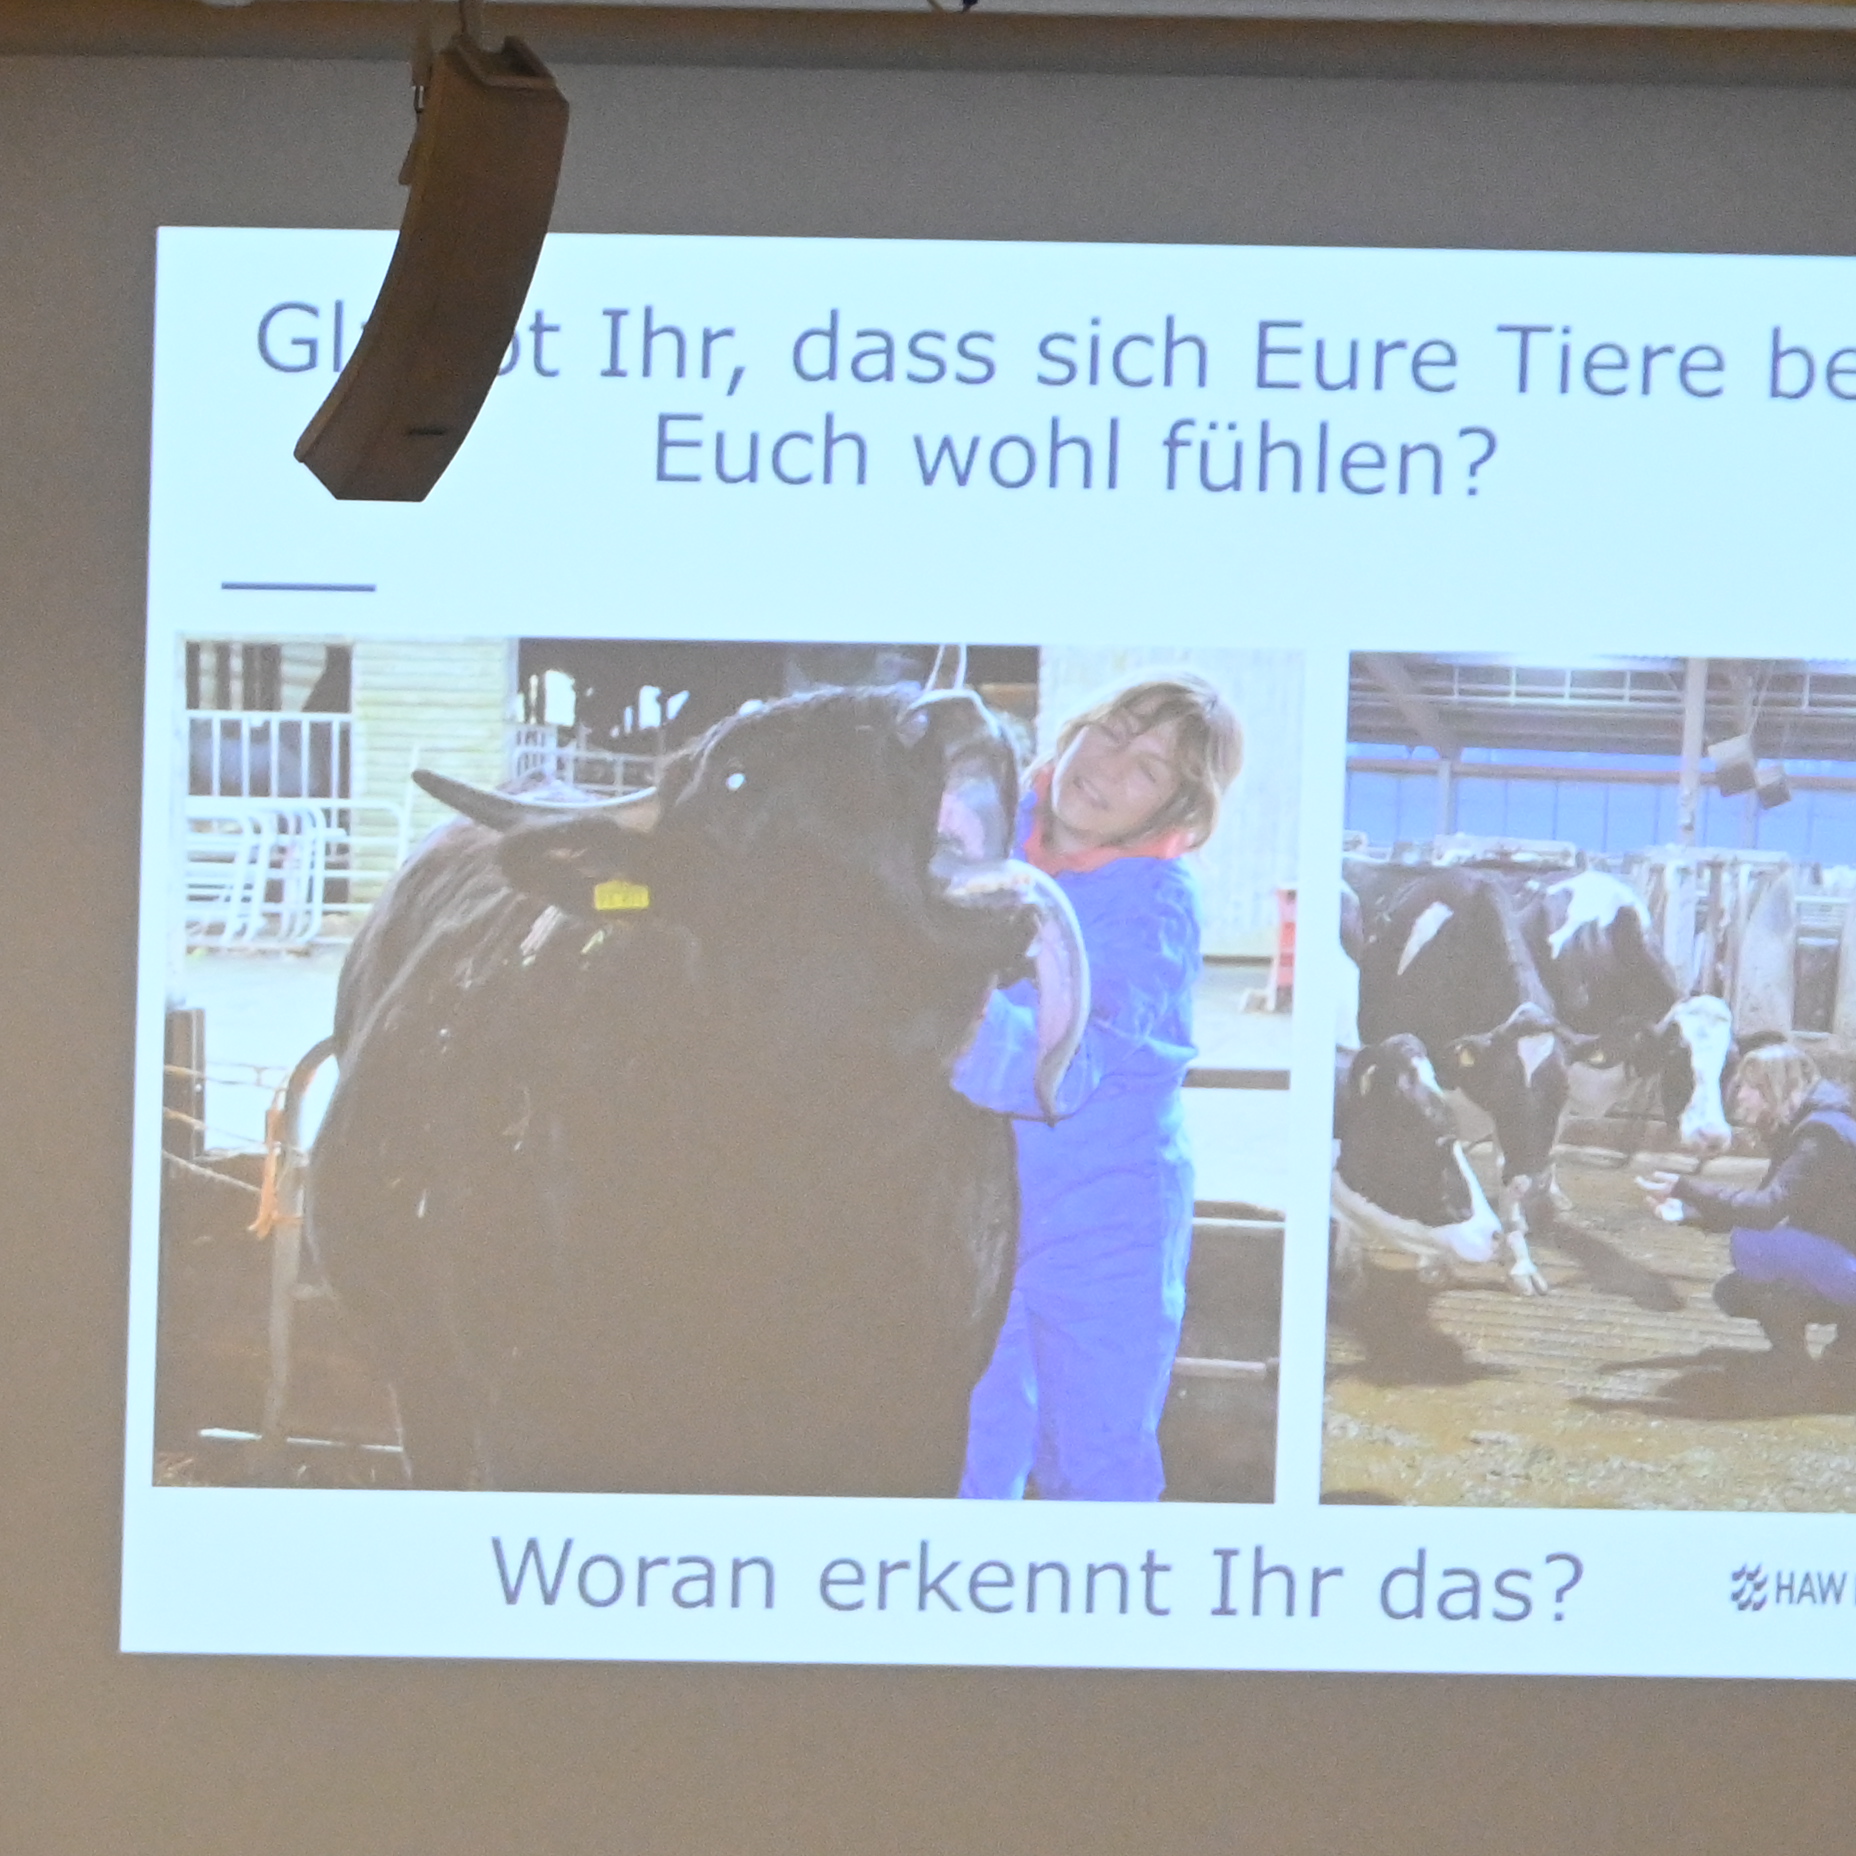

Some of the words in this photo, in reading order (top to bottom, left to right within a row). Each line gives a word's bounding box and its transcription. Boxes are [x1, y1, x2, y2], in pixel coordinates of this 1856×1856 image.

[256, 298, 561, 378] Glt
[598, 304, 747, 397] Ihr,
[792, 308, 997, 386] dass
[1036, 313, 1209, 389] sich
[1254, 319, 1459, 394] Eure
[1494, 323, 1726, 399] Tiere
[654, 411, 869, 486] Euch
[912, 415, 1121, 490] wohl
[1161, 416, 1499, 497] fühlen?
[490, 1536, 776, 1611] Woran
[818, 1539, 1173, 1617] erkennt
[1209, 1544, 1345, 1618] Ihr
[1378, 1547, 1585, 1623] das?
[1774, 1570, 1848, 1606] HAW
